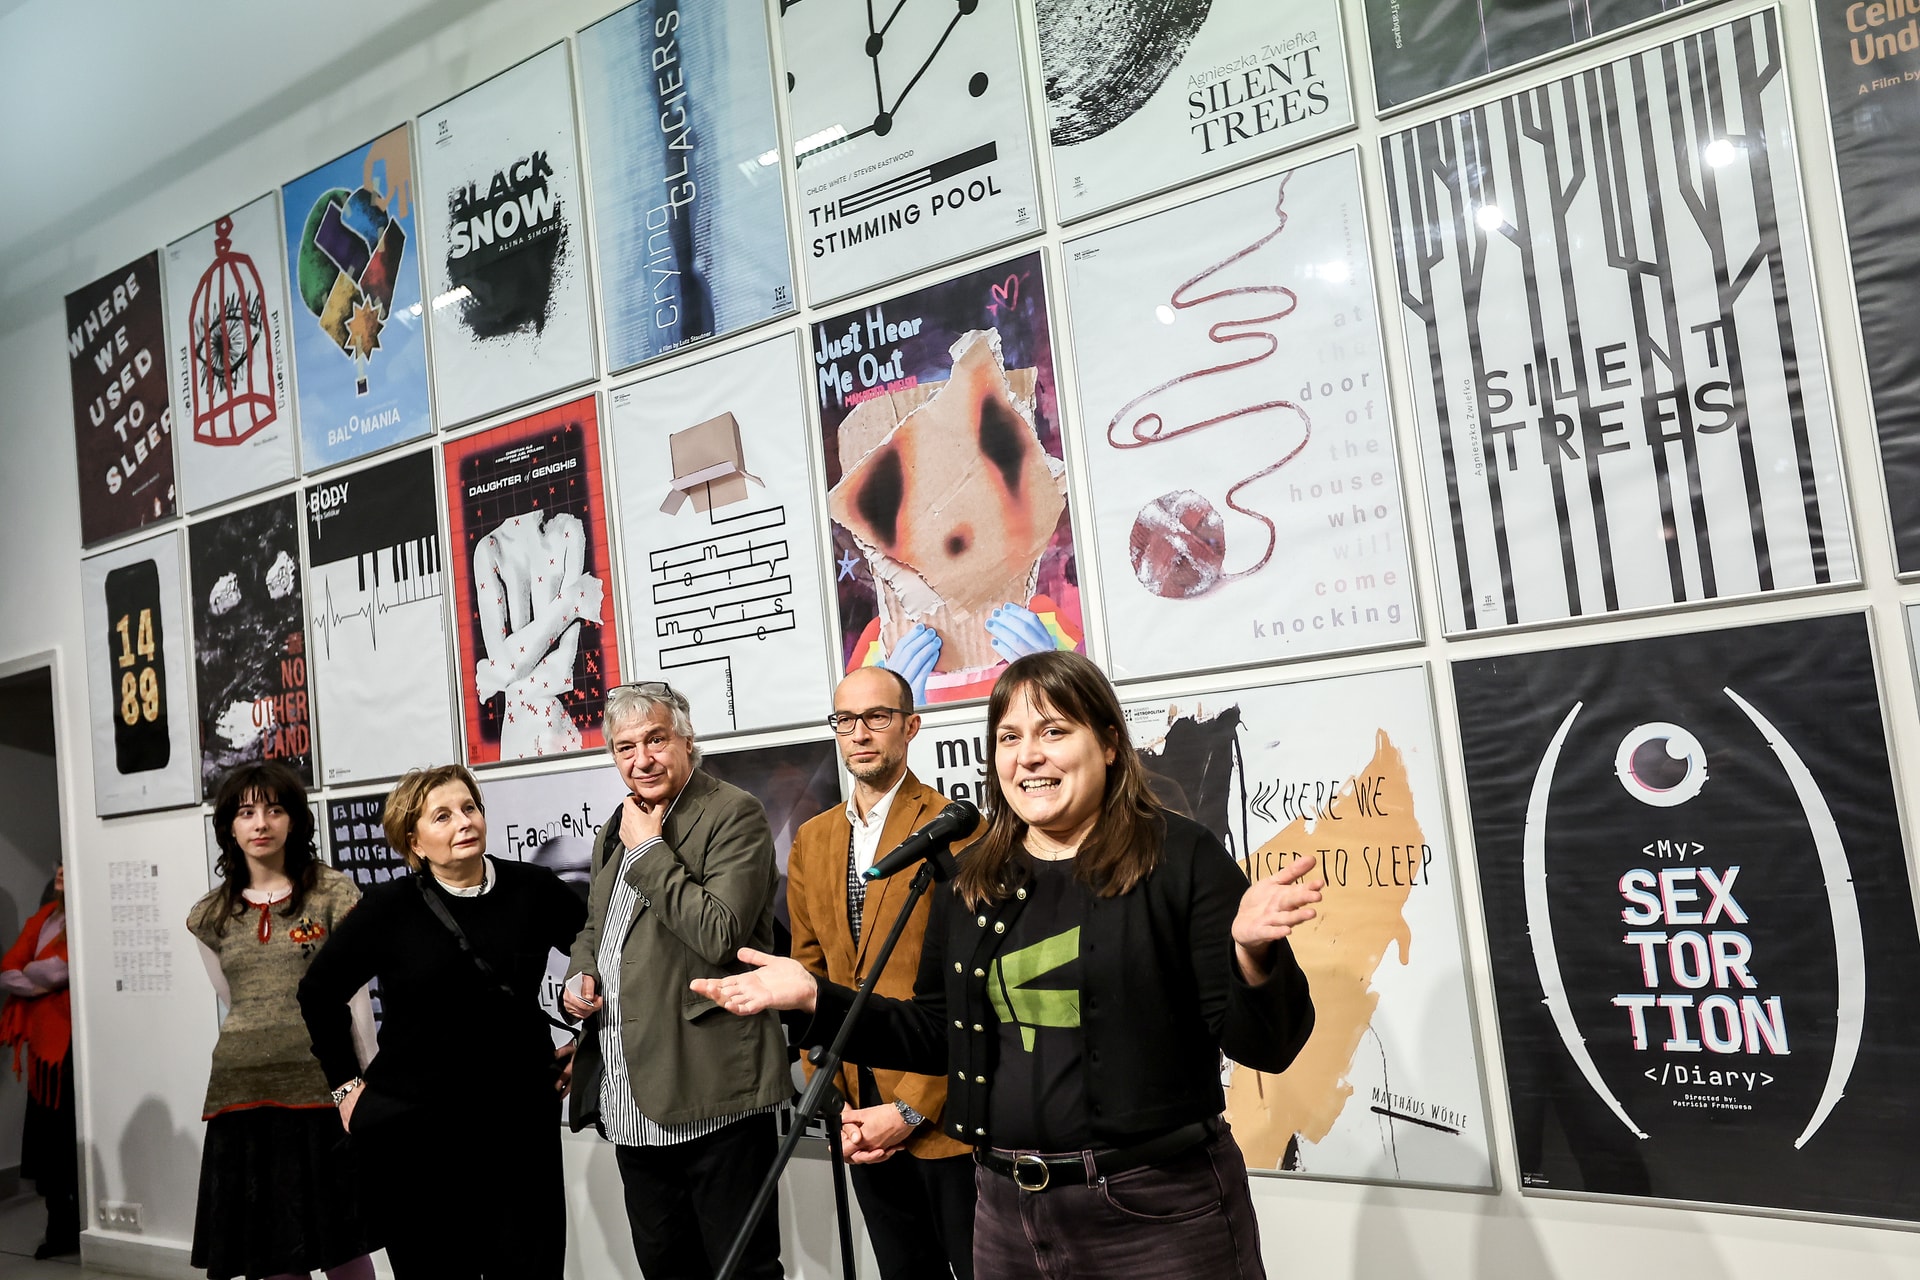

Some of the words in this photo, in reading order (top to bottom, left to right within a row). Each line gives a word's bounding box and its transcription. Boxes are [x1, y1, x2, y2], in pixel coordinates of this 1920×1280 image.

[1187, 54, 1258, 89] Agnieszka
[1261, 30, 1318, 61] Zwiefka
[1850, 19, 1920, 66] Und
[1188, 46, 1321, 121] SILENT
[1859, 84, 1869, 95] A
[1871, 76, 1901, 91] Film
[652, 10, 697, 220] GLACIERS
[1191, 80, 1330, 155] TREES
[449, 151, 554, 216] BLACK
[807, 183, 828, 196] CHLOE
[829, 174, 847, 188] WHITE
[854, 165, 877, 178] STEVEN
[878, 149, 915, 170] EASTWOOD
[450, 187, 556, 260] SNOW
[499, 237, 524, 253] ALINA
[527, 222, 561, 241] SIMONE
[813, 203, 921, 258] STIMMING
[931, 175, 1002, 216] POOL
[642, 202, 683, 331] crying
[67, 272, 141, 360] WHERE
[815, 321, 862, 365] Just
[865, 304, 923, 349] Hear
[1333, 304, 1363, 328] at
[94, 325, 129, 376] WE
[1484, 319, 1730, 416] SILENT
[89, 347, 153, 428] USED
[818, 361, 853, 407] Me
[858, 349, 905, 388] Out
[1299, 370, 1371, 402] door
[1463, 379, 1475, 420] Zwiefka
[113, 400, 145, 443] TO
[1344, 400, 1375, 426] of
[1490, 380, 1738, 471] TREES
[1329, 435, 1380, 462] the
[1469, 423, 1483, 477] Agnieszka
[310, 482, 349, 513] BODY
[469, 474, 522, 497] DAUGHTER
[523, 471, 531, 483] of
[532, 458, 577, 479] GENGHIS
[1289, 470, 1384, 503] house
[1327, 502, 1389, 528] who
[1333, 532, 1392, 561] will
[1314, 569, 1397, 597] come
[116, 608, 155, 669] 14
[1253, 602, 1401, 640] knocking
[281, 657, 306, 689] NO
[121, 667, 159, 726] 89
[252, 691, 308, 728] OTHER
[263, 724, 309, 760] LAND
[1353, 776, 1389, 818] WE
[1316, 848, 1349, 887] TO
[1363, 844, 1432, 887] SLEEP
[1618, 866, 1749, 926] SEX
[1622, 930, 1759, 989] TOR
[1610, 994, 1792, 1055] TION
[1372, 1086, 1427, 1118] MATTHÄUS
[1431, 1103, 1468, 1129] WÖRLE
[1672, 1100, 1708, 1109] Patricia
[1711, 1102, 1753, 1111] Franquesa
[1684, 1093, 1720, 1102] Directed
